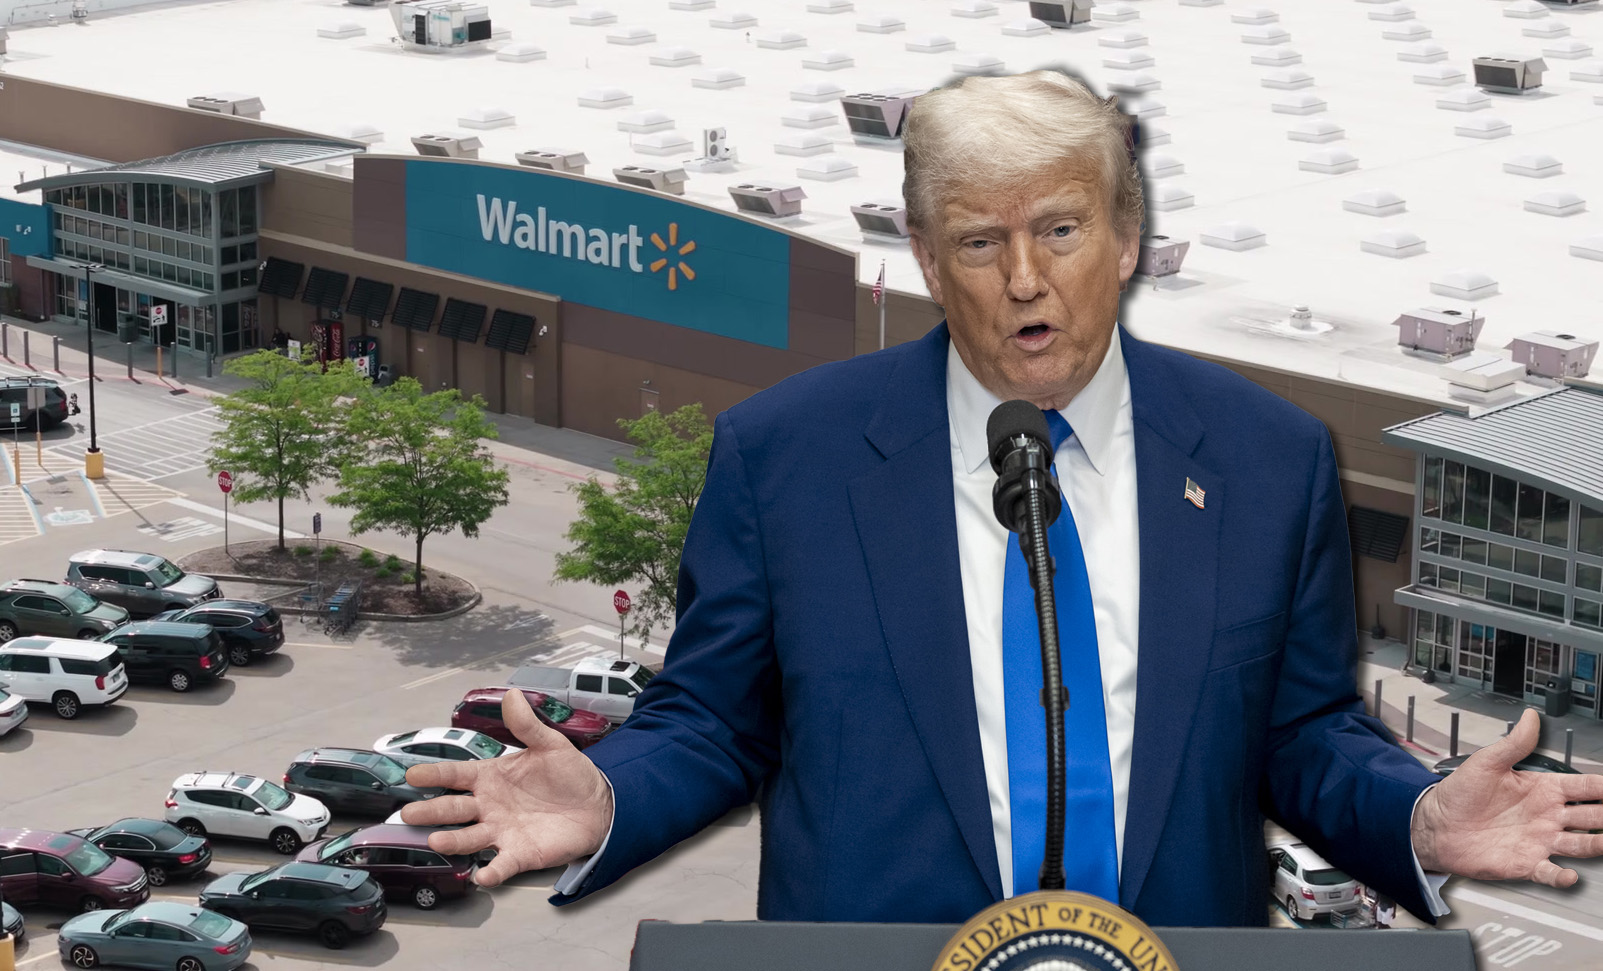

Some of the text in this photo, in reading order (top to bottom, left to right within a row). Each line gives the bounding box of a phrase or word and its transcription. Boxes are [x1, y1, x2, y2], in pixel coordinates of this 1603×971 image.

[476, 194, 643, 273] Walmart
[218, 476, 232, 488] STOP
[613, 596, 630, 609] STOP
[942, 904, 1047, 971] SIDENT
[1058, 907, 1082, 924] OF
[1089, 911, 1122, 940] THE
